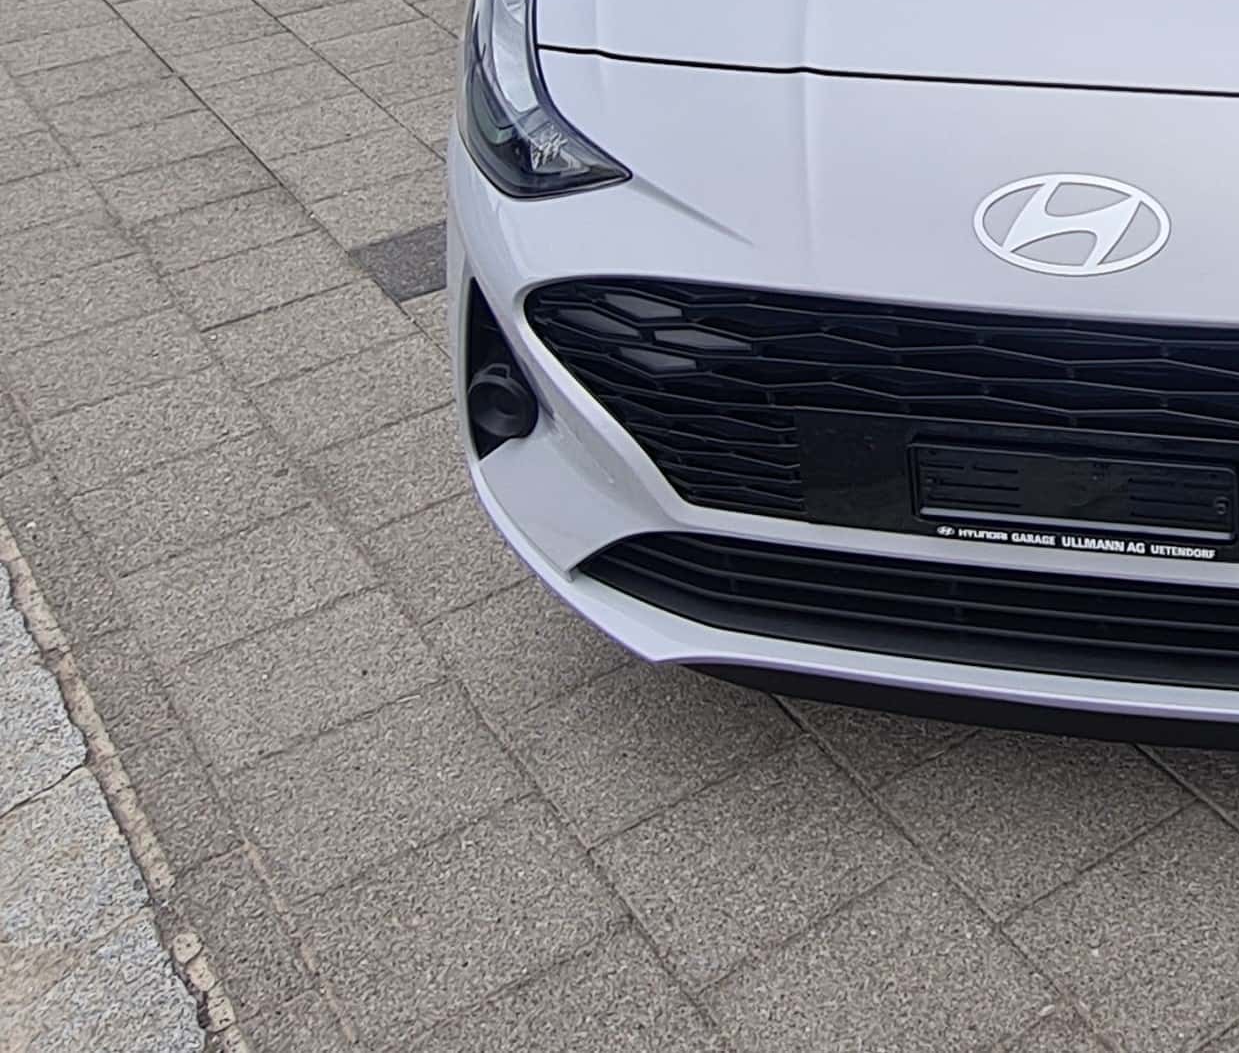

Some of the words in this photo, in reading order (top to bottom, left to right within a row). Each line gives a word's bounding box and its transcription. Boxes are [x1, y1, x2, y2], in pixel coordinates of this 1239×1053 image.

[958, 528, 1008, 541] HYUNDAI
[1011, 532, 1056, 546] GARAGE
[1061, 535, 1125, 553] ULLMANN
[1126, 542, 1146, 554] AG
[1150, 544, 1216, 559] UETENDORF
